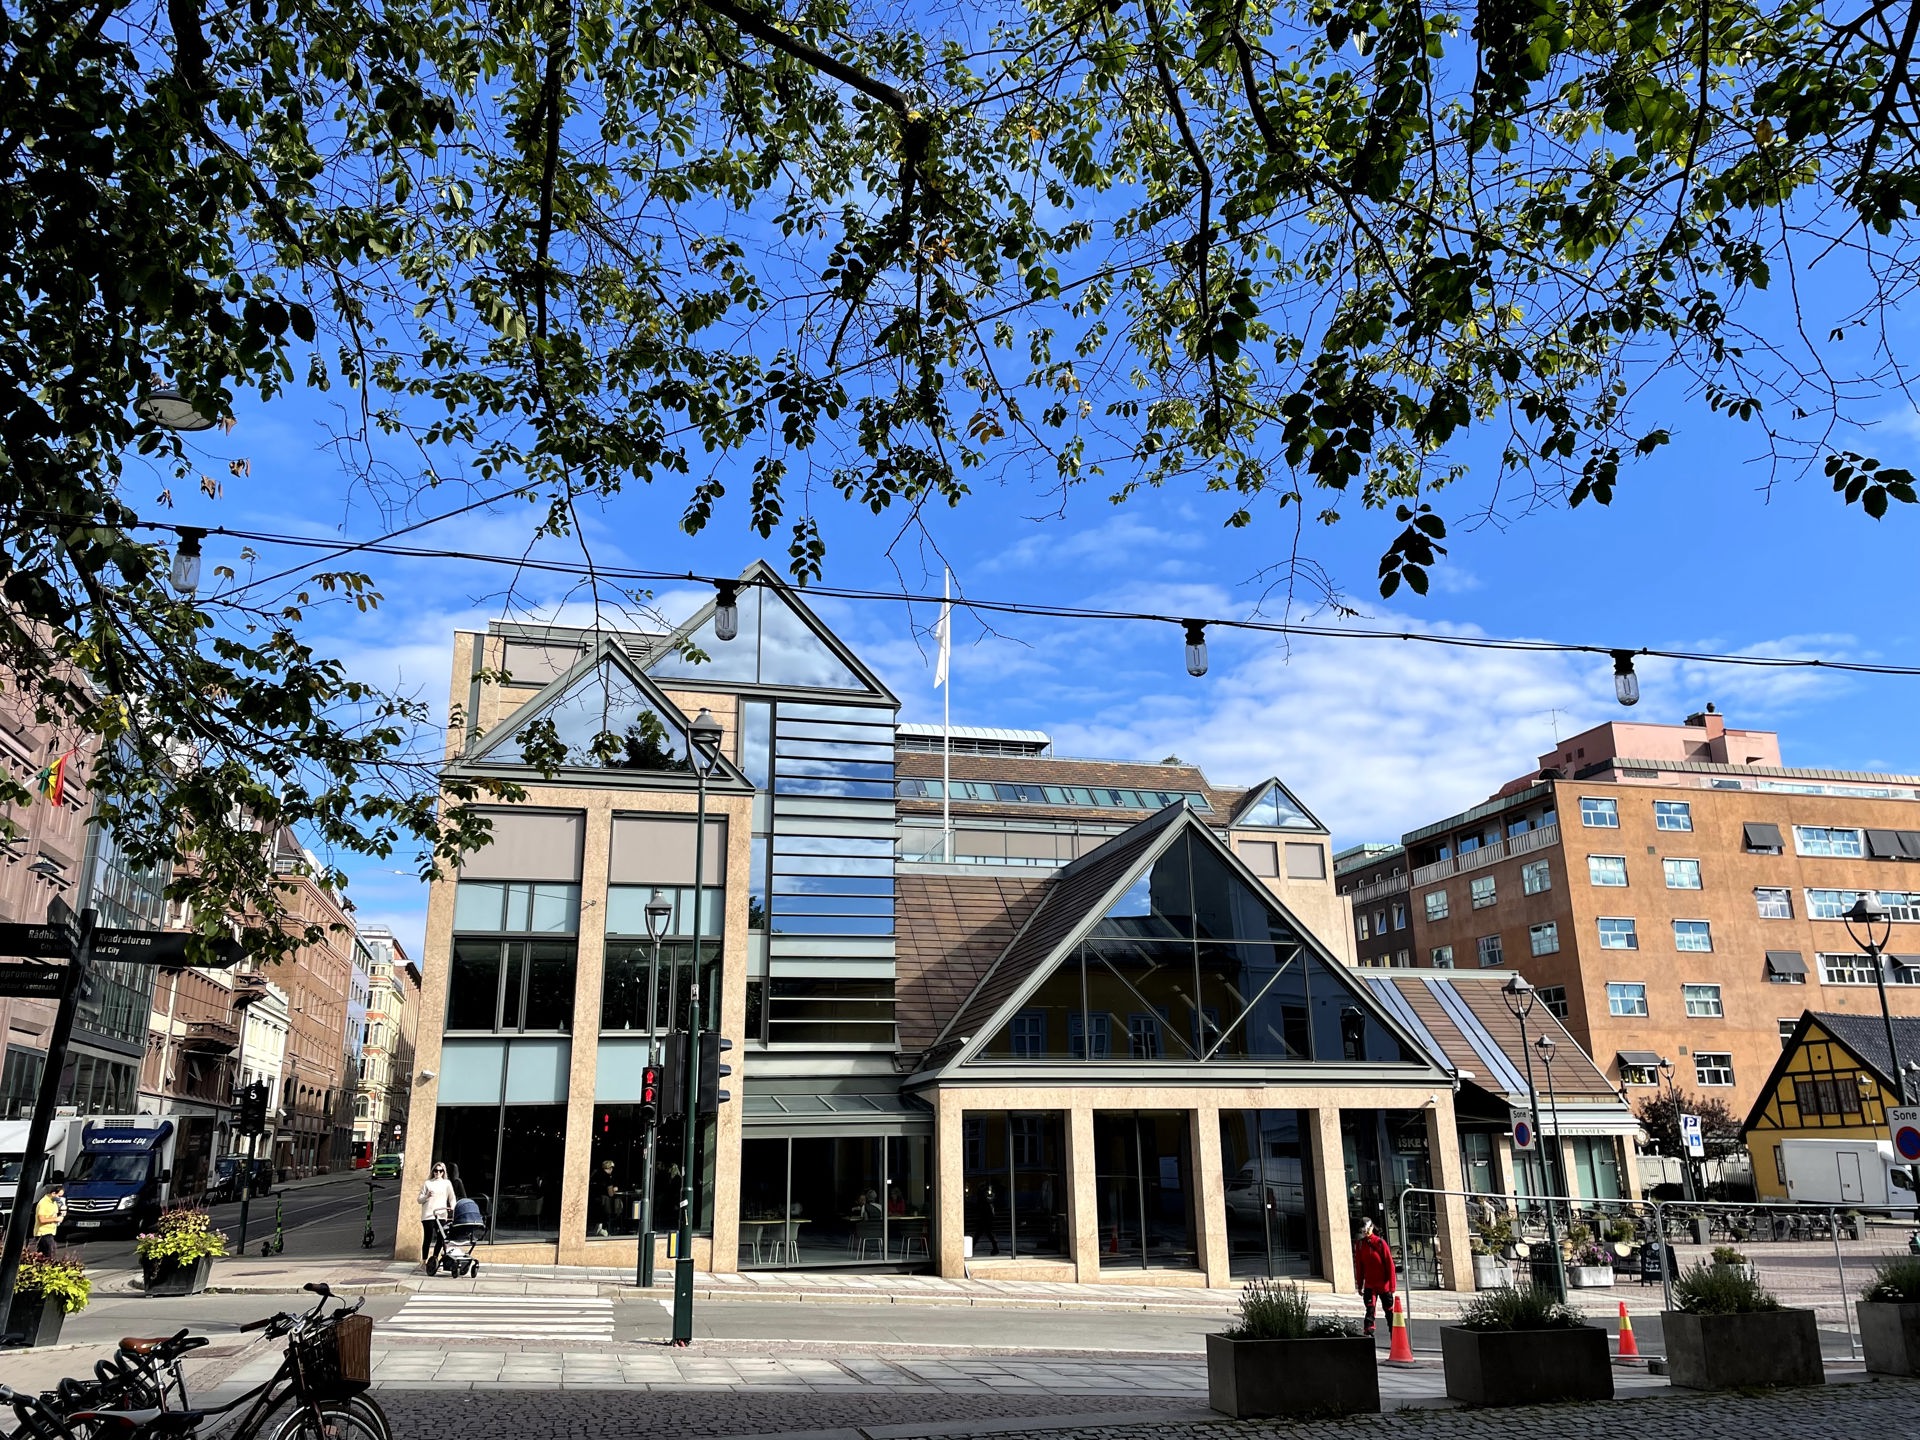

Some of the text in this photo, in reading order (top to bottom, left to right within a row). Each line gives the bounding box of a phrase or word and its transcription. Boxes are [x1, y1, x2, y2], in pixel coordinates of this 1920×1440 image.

[98, 933, 152, 946] Kvadraturen
[95, 945, 120, 955] Old City
[1513, 1110, 1527, 1118] Sone
[1893, 1110, 1918, 1120] Sone
[92, 1137, 107, 1145] Carl
